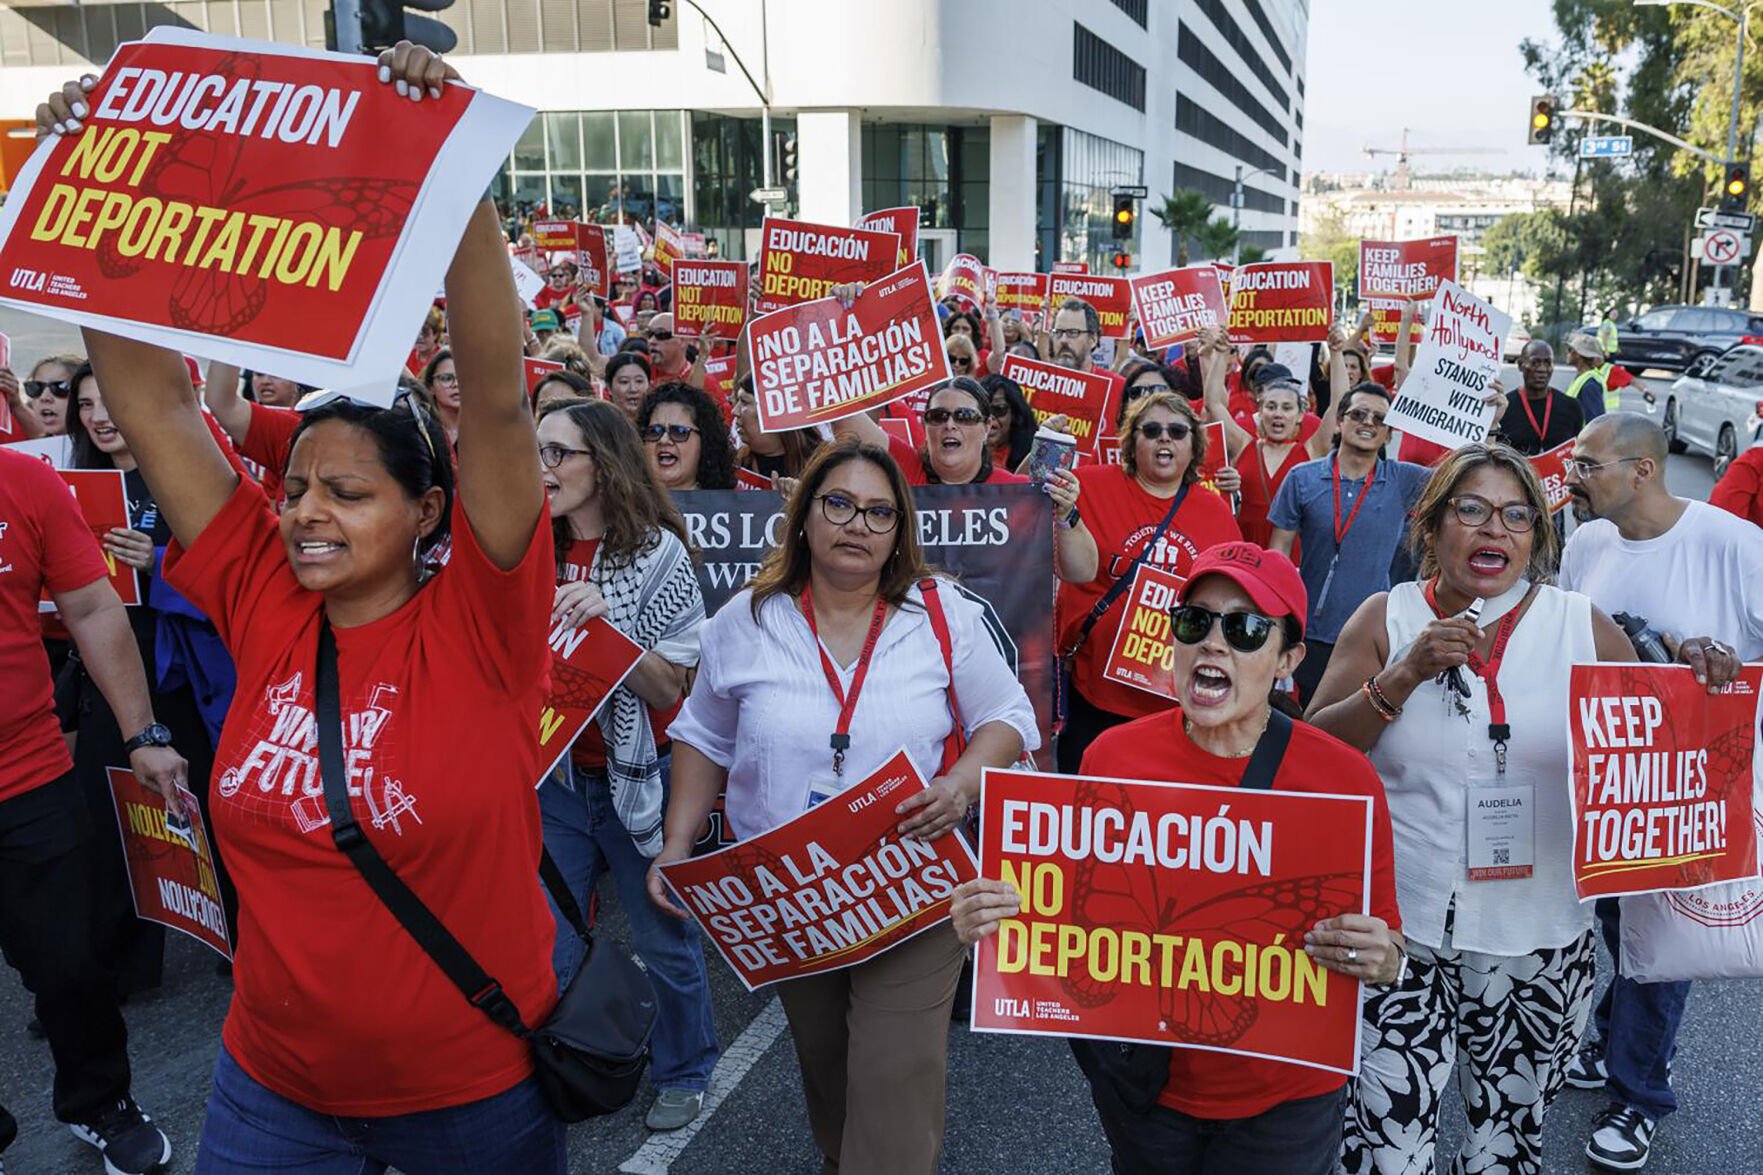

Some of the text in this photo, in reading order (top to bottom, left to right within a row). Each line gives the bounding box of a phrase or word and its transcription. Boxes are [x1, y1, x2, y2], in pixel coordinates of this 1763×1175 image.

[95, 67, 361, 148] EDUCATION
[61, 125, 171, 187] NOT
[1586, 140, 1627, 153] 3rd St
[31, 184, 363, 292] DEPORTATION
[769, 228, 869, 262] EDUCACIÓN
[766, 250, 792, 274] NO
[1364, 262, 1427, 278] FAMILIES
[1365, 248, 1400, 262] KEEP
[9, 267, 47, 291] UTLA
[678, 267, 736, 288] EDUCATION
[879, 285, 896, 298] UTLA
[1052, 279, 1113, 297] EDUCATION
[1139, 280, 1175, 304] KEEP
[1236, 270, 1310, 292] EDUCATION
[1364, 275, 1439, 293] TOGETHER!
[678, 286, 702, 304] NOT
[1143, 293, 1206, 321] FAMILIES
[1147, 309, 1218, 339] TOGETHER!
[1229, 308, 1328, 328] DEPORTATION
[1443, 288, 1493, 336] North
[757, 313, 863, 362] ¡NO A LA
[760, 317, 922, 389] SEPARACIÓN
[764, 382, 803, 418] DE
[805, 343, 934, 410] FAMILIAS!
[1009, 364, 1087, 400] EDUCATION
[1434, 358, 1487, 392] STANDS
[1448, 389, 1485, 419] WITH
[1394, 396, 1484, 443] IMMIGRANTS
[739, 512, 786, 549] LO
[915, 507, 1010, 546] ELES
[1579, 696, 1663, 748] KEEP
[1587, 748, 1708, 805] FAMILIES
[848, 791, 877, 813] UTLA
[1478, 798, 1522, 809] AUDELIA
[1001, 799, 1273, 877] EDUCACIÓN
[1583, 799, 1727, 863] TOGETHER!
[683, 840, 840, 916] ¡NO A LA
[709, 837, 939, 946] SEPARACIÓN
[1000, 859, 1064, 917] NO
[157, 877, 227, 940] EDUCATION
[731, 859, 960, 971] DE FAMILIAS!
[1689, 893, 1709, 909] LOS
[996, 919, 1329, 1007] DEPORTACIÓN
[995, 998, 1030, 1017] UTLA
[1036, 1000, 1061, 1008] UNITED
[1036, 1006, 1070, 1015] TEACHERS
[1050, 1013, 1080, 1021] ANGELES
